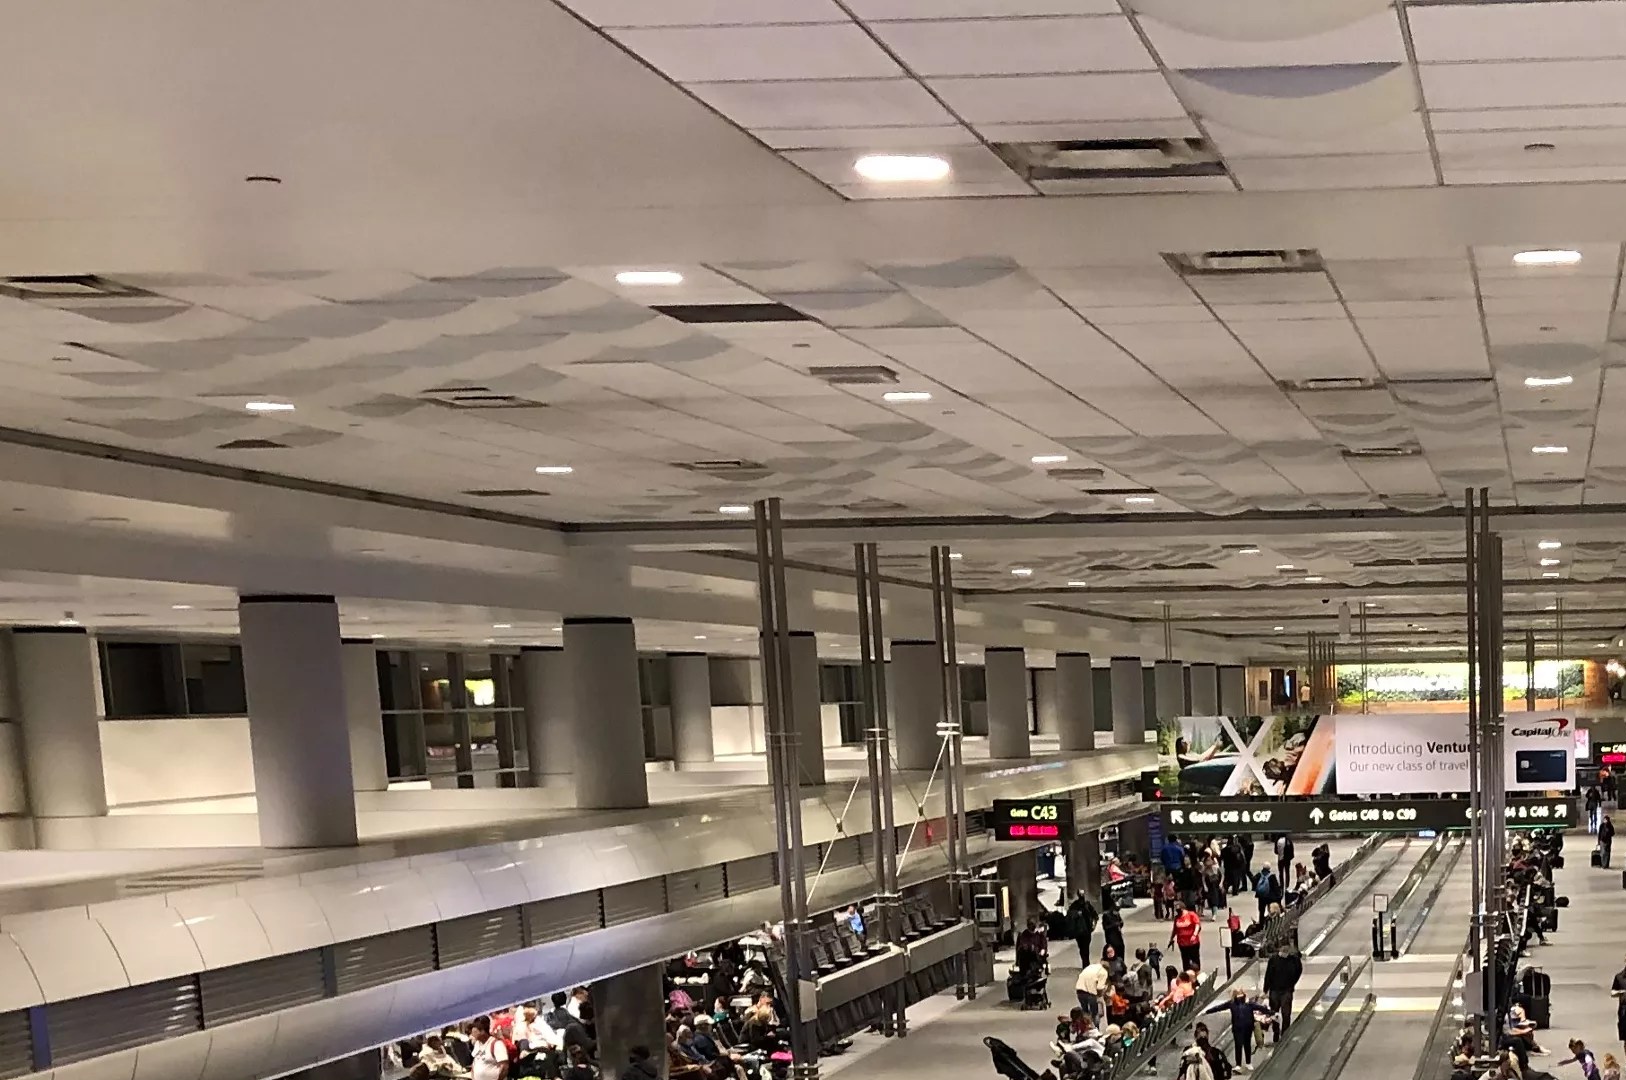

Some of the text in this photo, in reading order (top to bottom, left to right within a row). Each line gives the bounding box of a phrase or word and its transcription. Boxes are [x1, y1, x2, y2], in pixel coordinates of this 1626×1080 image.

[1349, 742, 1423, 756] Introducing
[1349, 759, 1469, 772] Our new class of travel
[1030, 805, 1058, 820] C43
[1381, 809, 1395, 822] to
